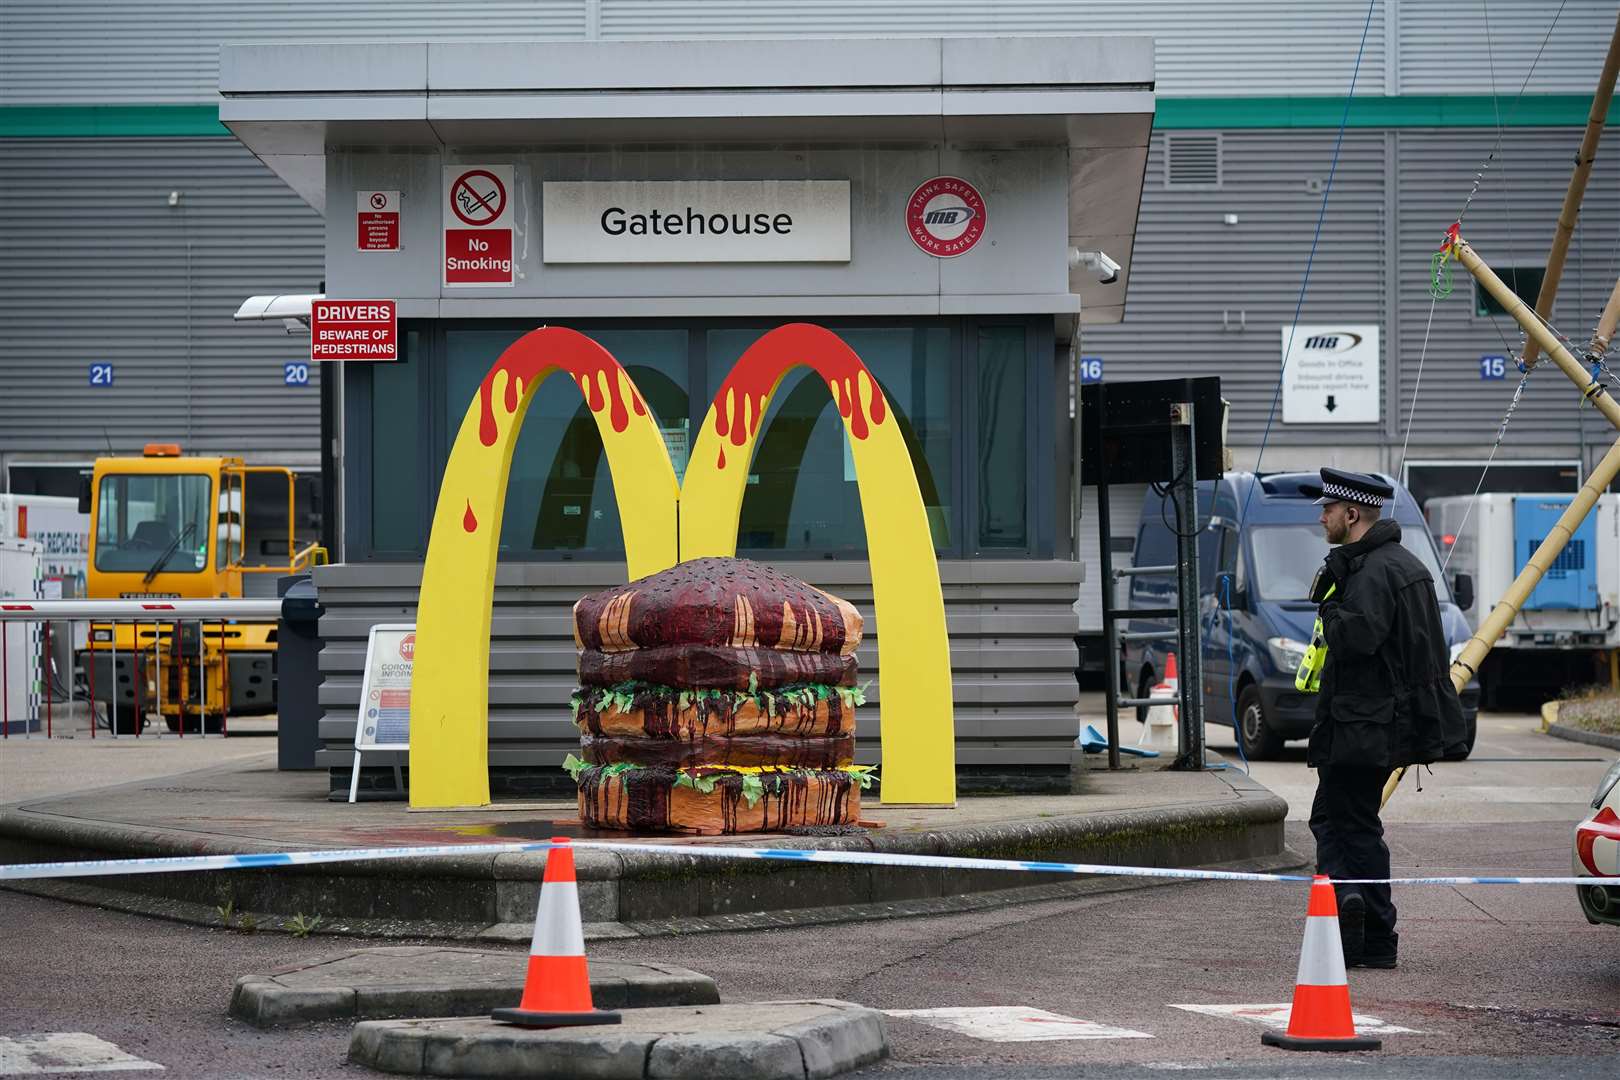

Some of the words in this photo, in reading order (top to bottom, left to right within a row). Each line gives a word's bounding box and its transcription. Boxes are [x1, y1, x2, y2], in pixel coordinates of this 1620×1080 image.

[914, 184, 941, 208] THINK
[945, 182, 980, 207] SAFETY
[601, 206, 793, 236] Gatehouse
[925, 211, 958, 224] MB
[468, 238, 489, 252] No
[915, 226, 940, 250] WORK
[945, 226, 979, 251] SAFELY
[447, 257, 511, 273] Smoking
[317, 306, 390, 320] DRIVERS
[319, 330, 368, 340] BEWARE
[372, 330, 389, 340] OF
[313, 344, 395, 354] PEDESTRIANS
[92, 366, 112, 384] 21
[285, 365, 308, 383] 20
[1081, 360, 1101, 379] 16
[1482, 359, 1504, 376] 15
[381, 663, 413, 671] CORON
[381, 670, 413, 678] INFORM
